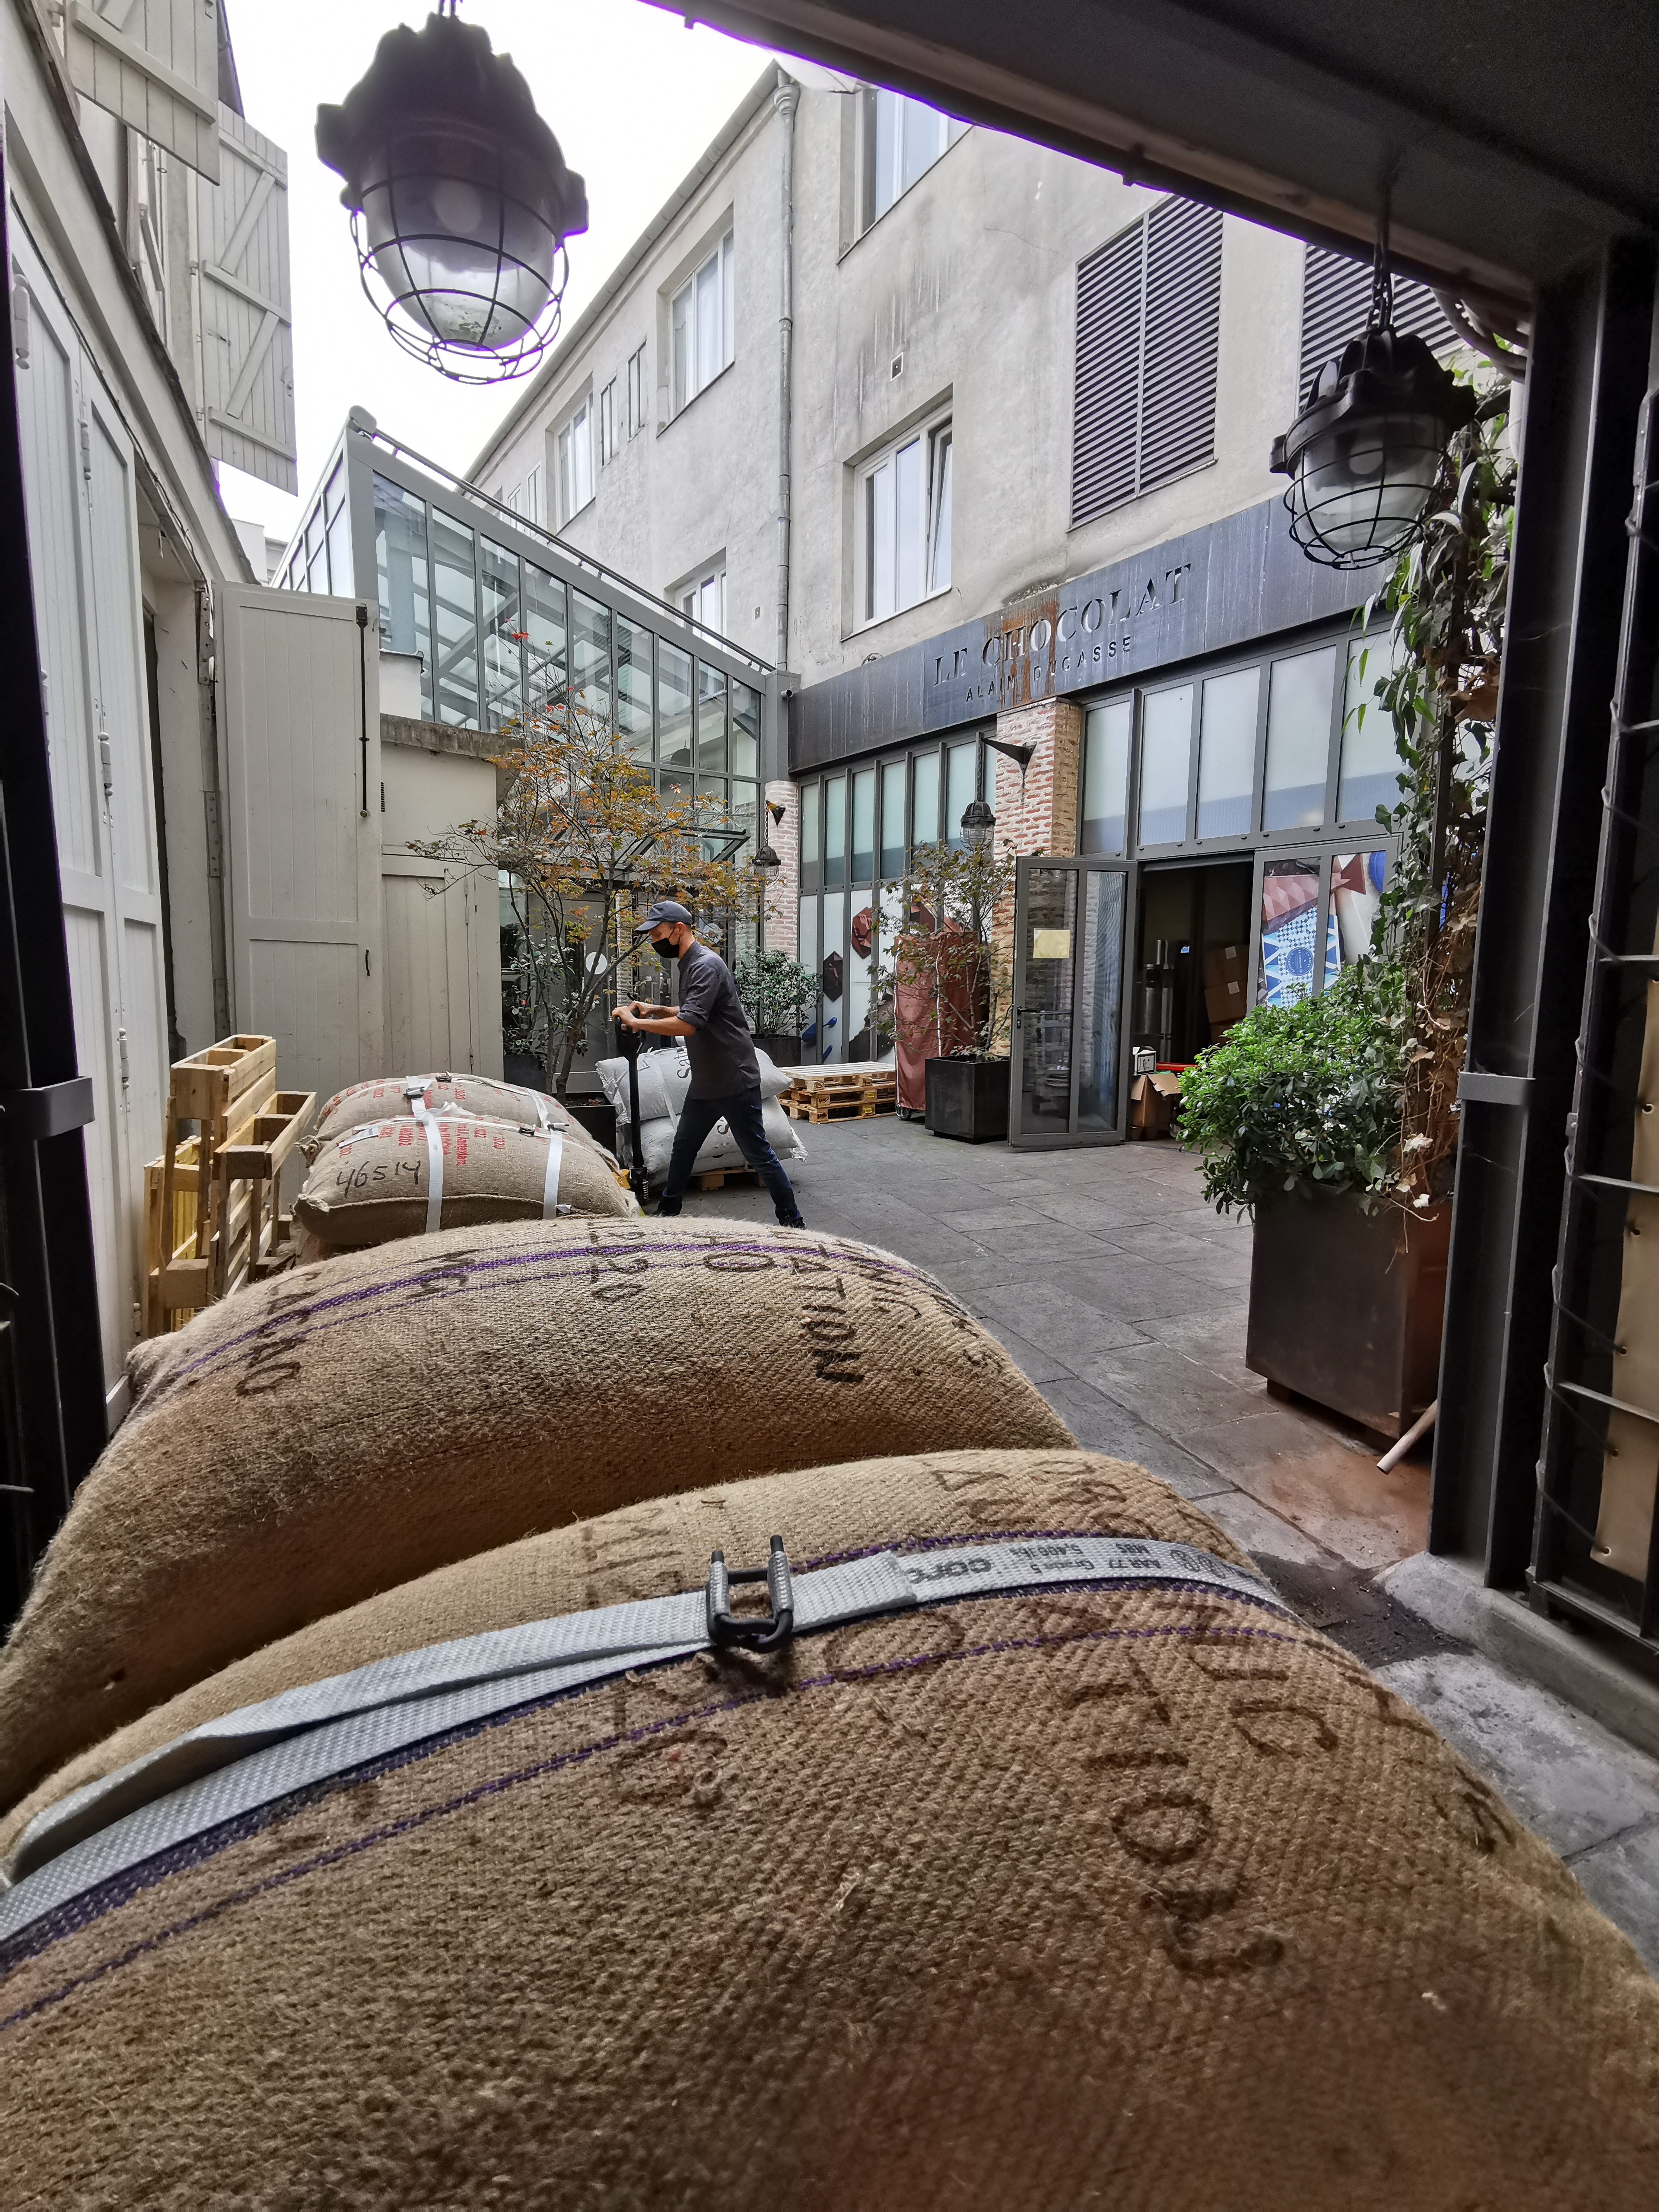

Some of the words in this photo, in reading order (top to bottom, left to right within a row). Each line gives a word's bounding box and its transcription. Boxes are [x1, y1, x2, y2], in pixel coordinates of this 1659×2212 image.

[934, 648, 967, 685] LE
[982, 563, 1191, 667] CHOCOLAT
[966, 674, 1014, 702] ALAIN
[1033, 636, 1132, 681] DUCASSE
[474, 1128, 486, 1138] 2022
[493, 1137, 505, 1149] 2020
[457, 1137, 470, 1165] Amsterdam
[336, 1159, 421, 1199] 46514
[235, 1271, 322, 1397] CACAO
[1030, 1564, 1042, 1574] 5
[1109, 1559, 1128, 1569] 77
